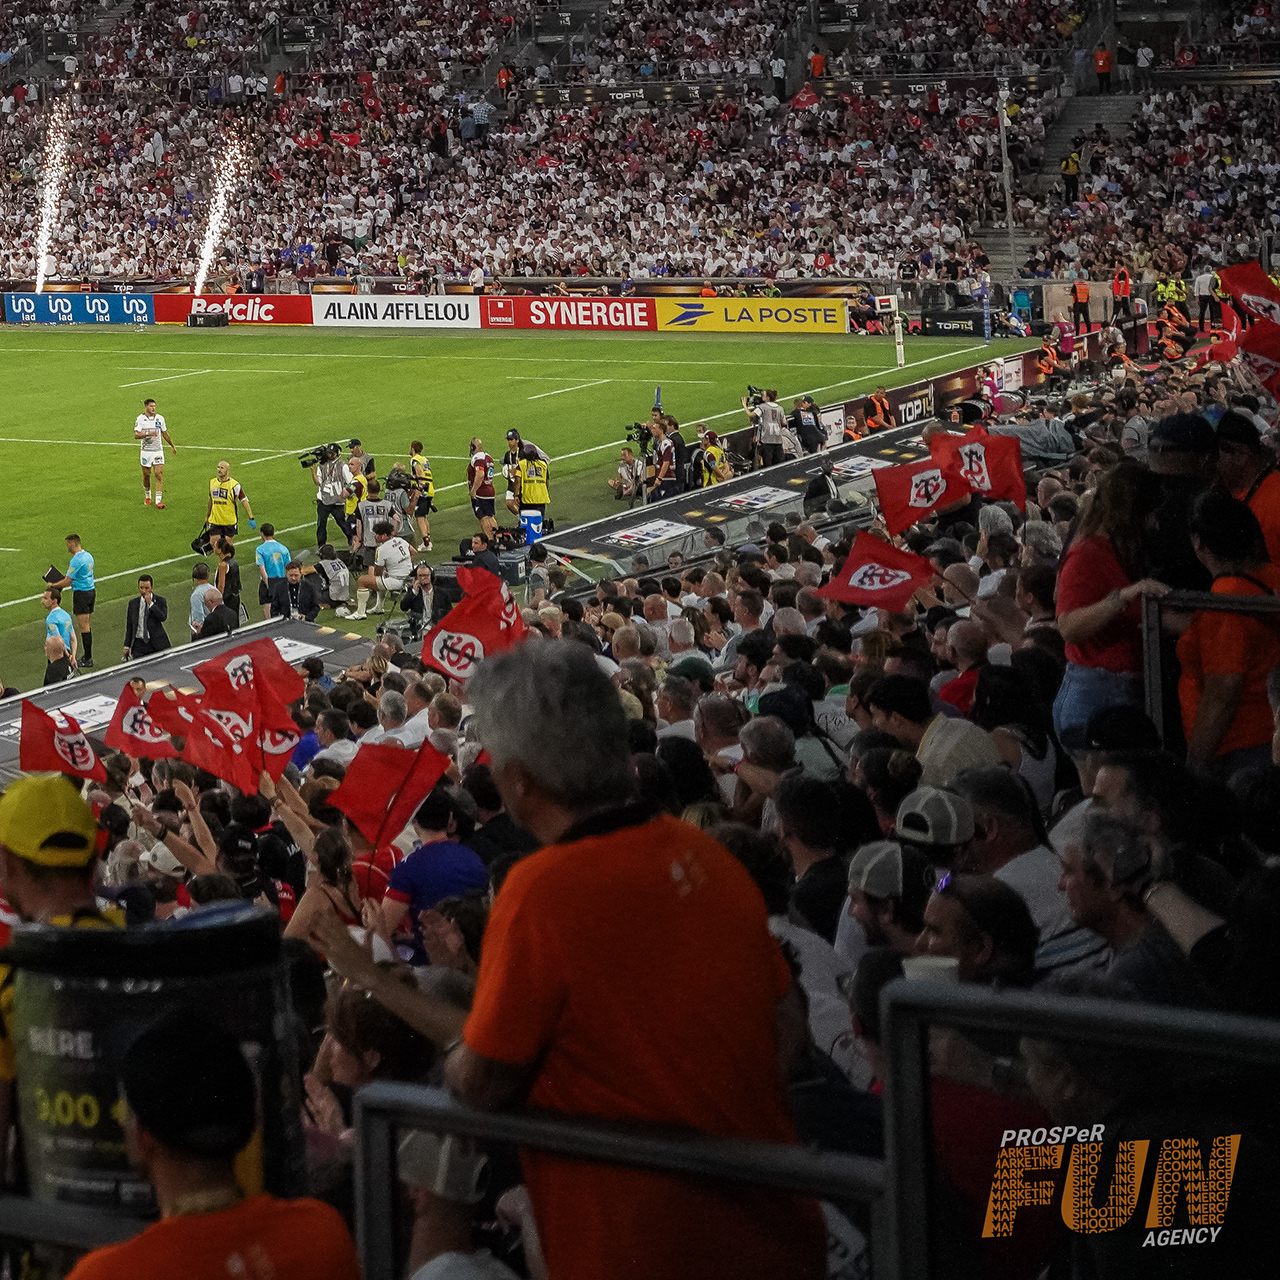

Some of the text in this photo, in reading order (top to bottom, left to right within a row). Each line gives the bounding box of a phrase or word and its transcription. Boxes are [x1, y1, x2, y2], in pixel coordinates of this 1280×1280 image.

[324, 302, 470, 321] ALAIN AFFLELOU
[530, 300, 649, 326] SYNERGIE
[724, 308, 837, 324] LA POSTE
[936, 320, 973, 332] TOP14
